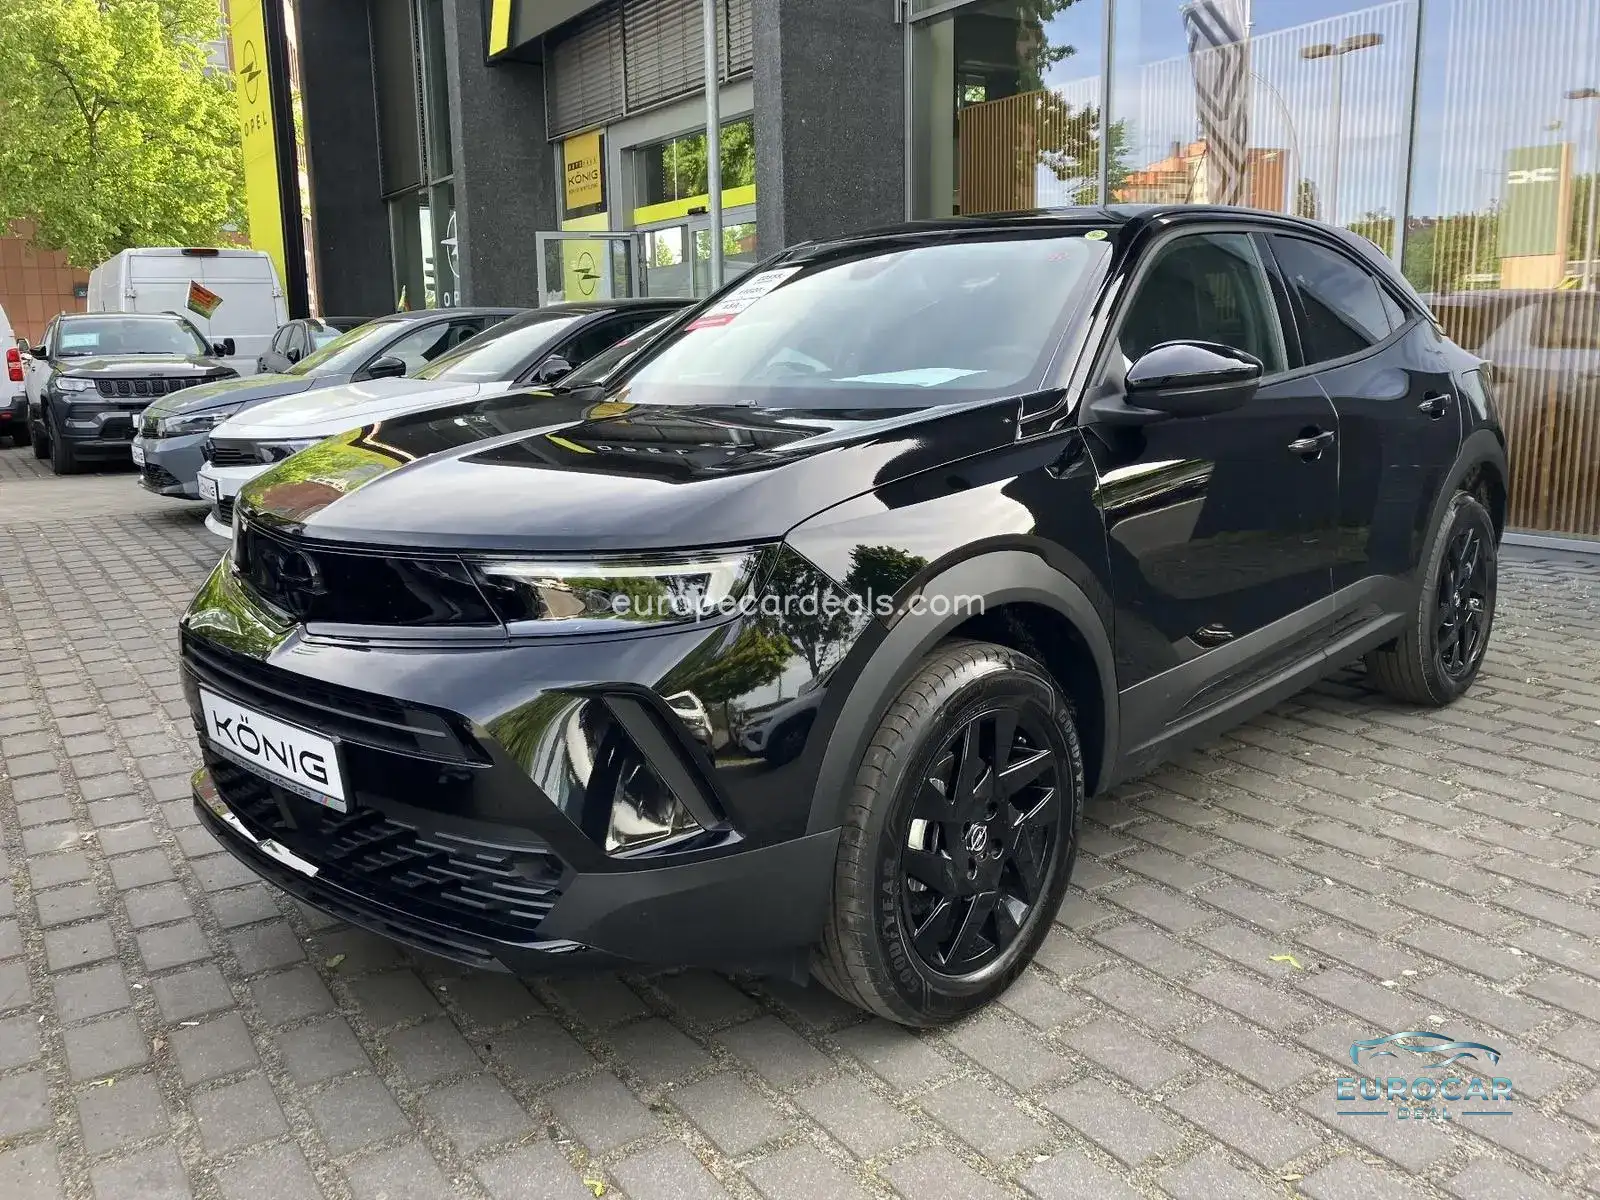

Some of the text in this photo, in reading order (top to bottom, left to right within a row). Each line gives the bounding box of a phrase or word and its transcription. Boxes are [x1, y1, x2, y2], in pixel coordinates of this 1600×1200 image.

[244, 111, 268, 137] OPEL
[568, 169, 598, 186] KÖNIG
[212, 710, 329, 785] KÖNIG
[882, 858, 920, 993] GOODYEAR
